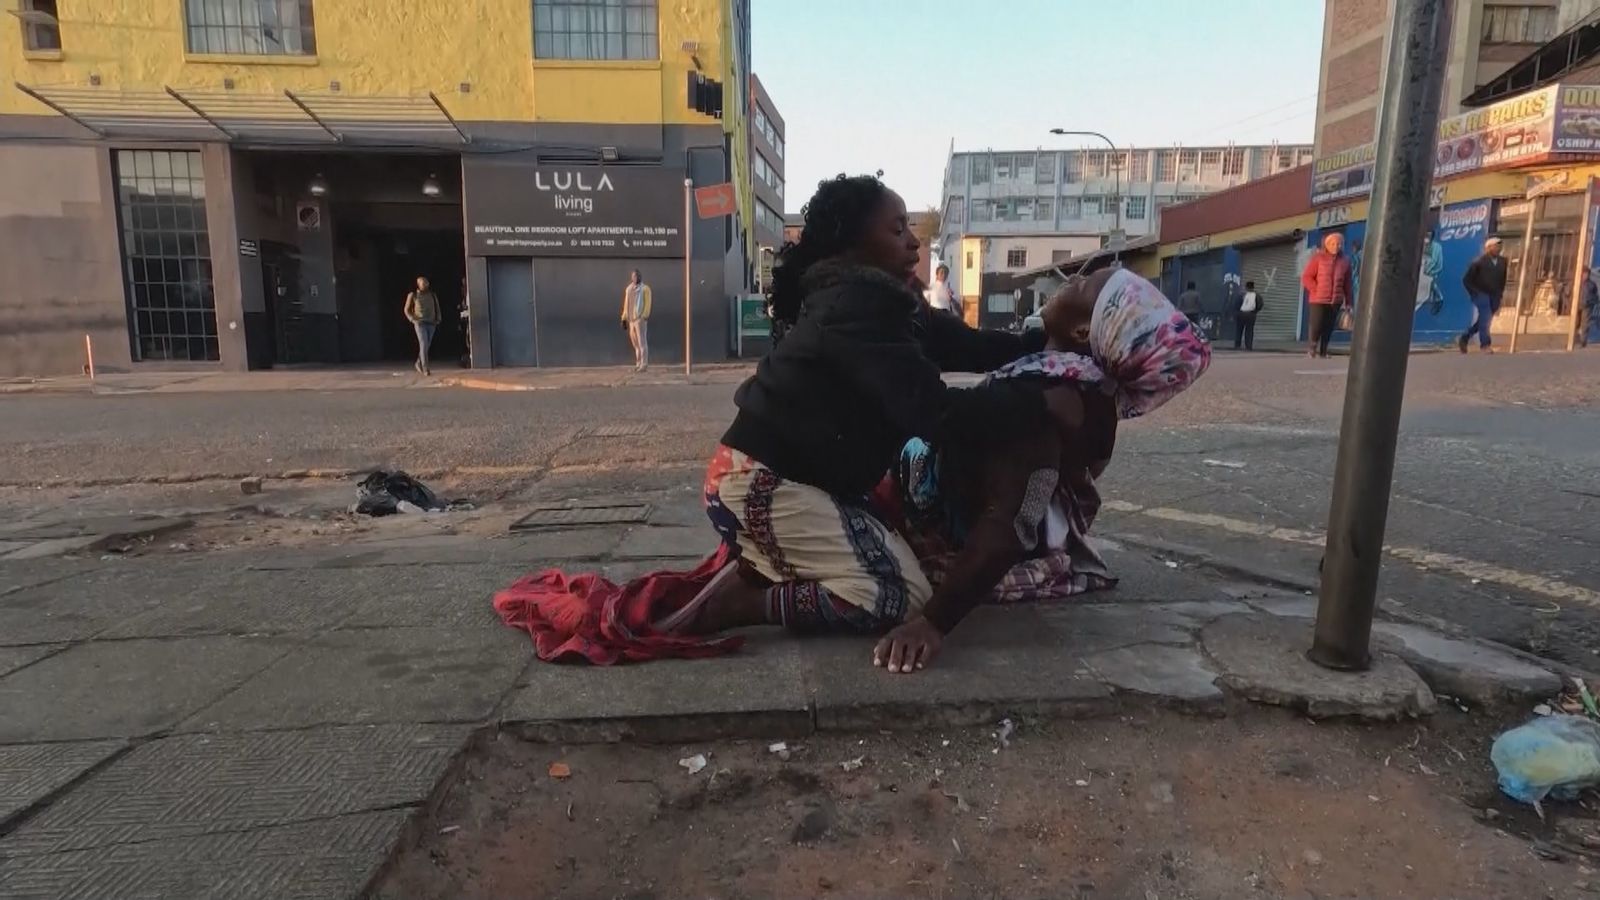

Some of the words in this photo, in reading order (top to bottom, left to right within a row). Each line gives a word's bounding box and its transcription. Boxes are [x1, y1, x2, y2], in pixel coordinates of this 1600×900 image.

[1564, 88, 1600, 106] DO
[535, 171, 614, 192] LULA
[554, 194, 593, 213] living
[531, 226, 567, 234] BEDROOM
[568, 226, 586, 234] LOFT
[587, 227, 634, 235] APARTMENTS
